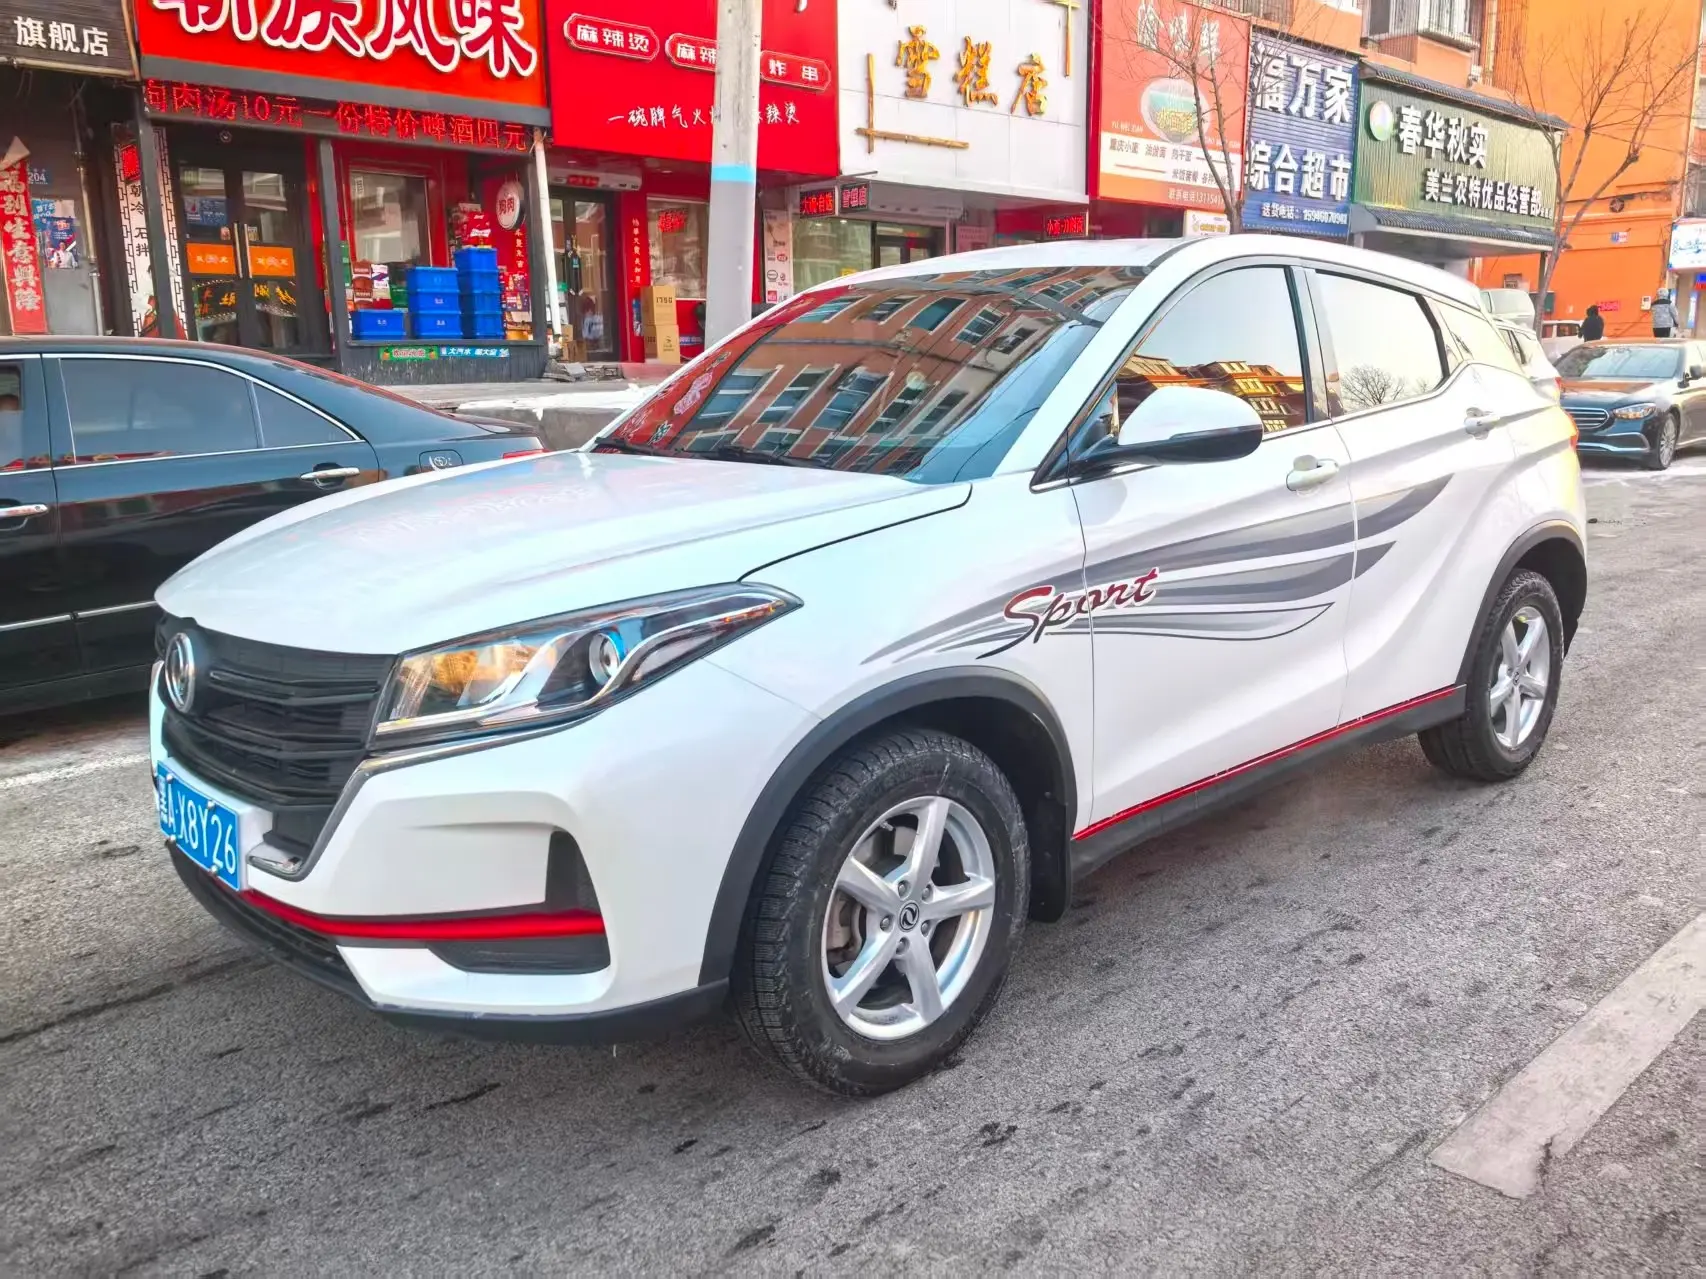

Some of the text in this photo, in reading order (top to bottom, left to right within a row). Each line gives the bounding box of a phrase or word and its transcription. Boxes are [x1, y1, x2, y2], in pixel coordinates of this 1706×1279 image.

[14, 16, 109, 57] 旗舰店
[576, 24, 649, 52] 麻辣烫
[676, 43, 717, 65] 麻辣
[768, 59, 818, 81] 炸串
[895, 25, 1047, 116] 雪糕店
[1398, 105, 1489, 168] 春华秋实
[1244, 140, 1352, 201] 综合超市
[1425, 168, 1542, 217] 美兰农特优品经营部
[975, 566, 1160, 660] Sport
